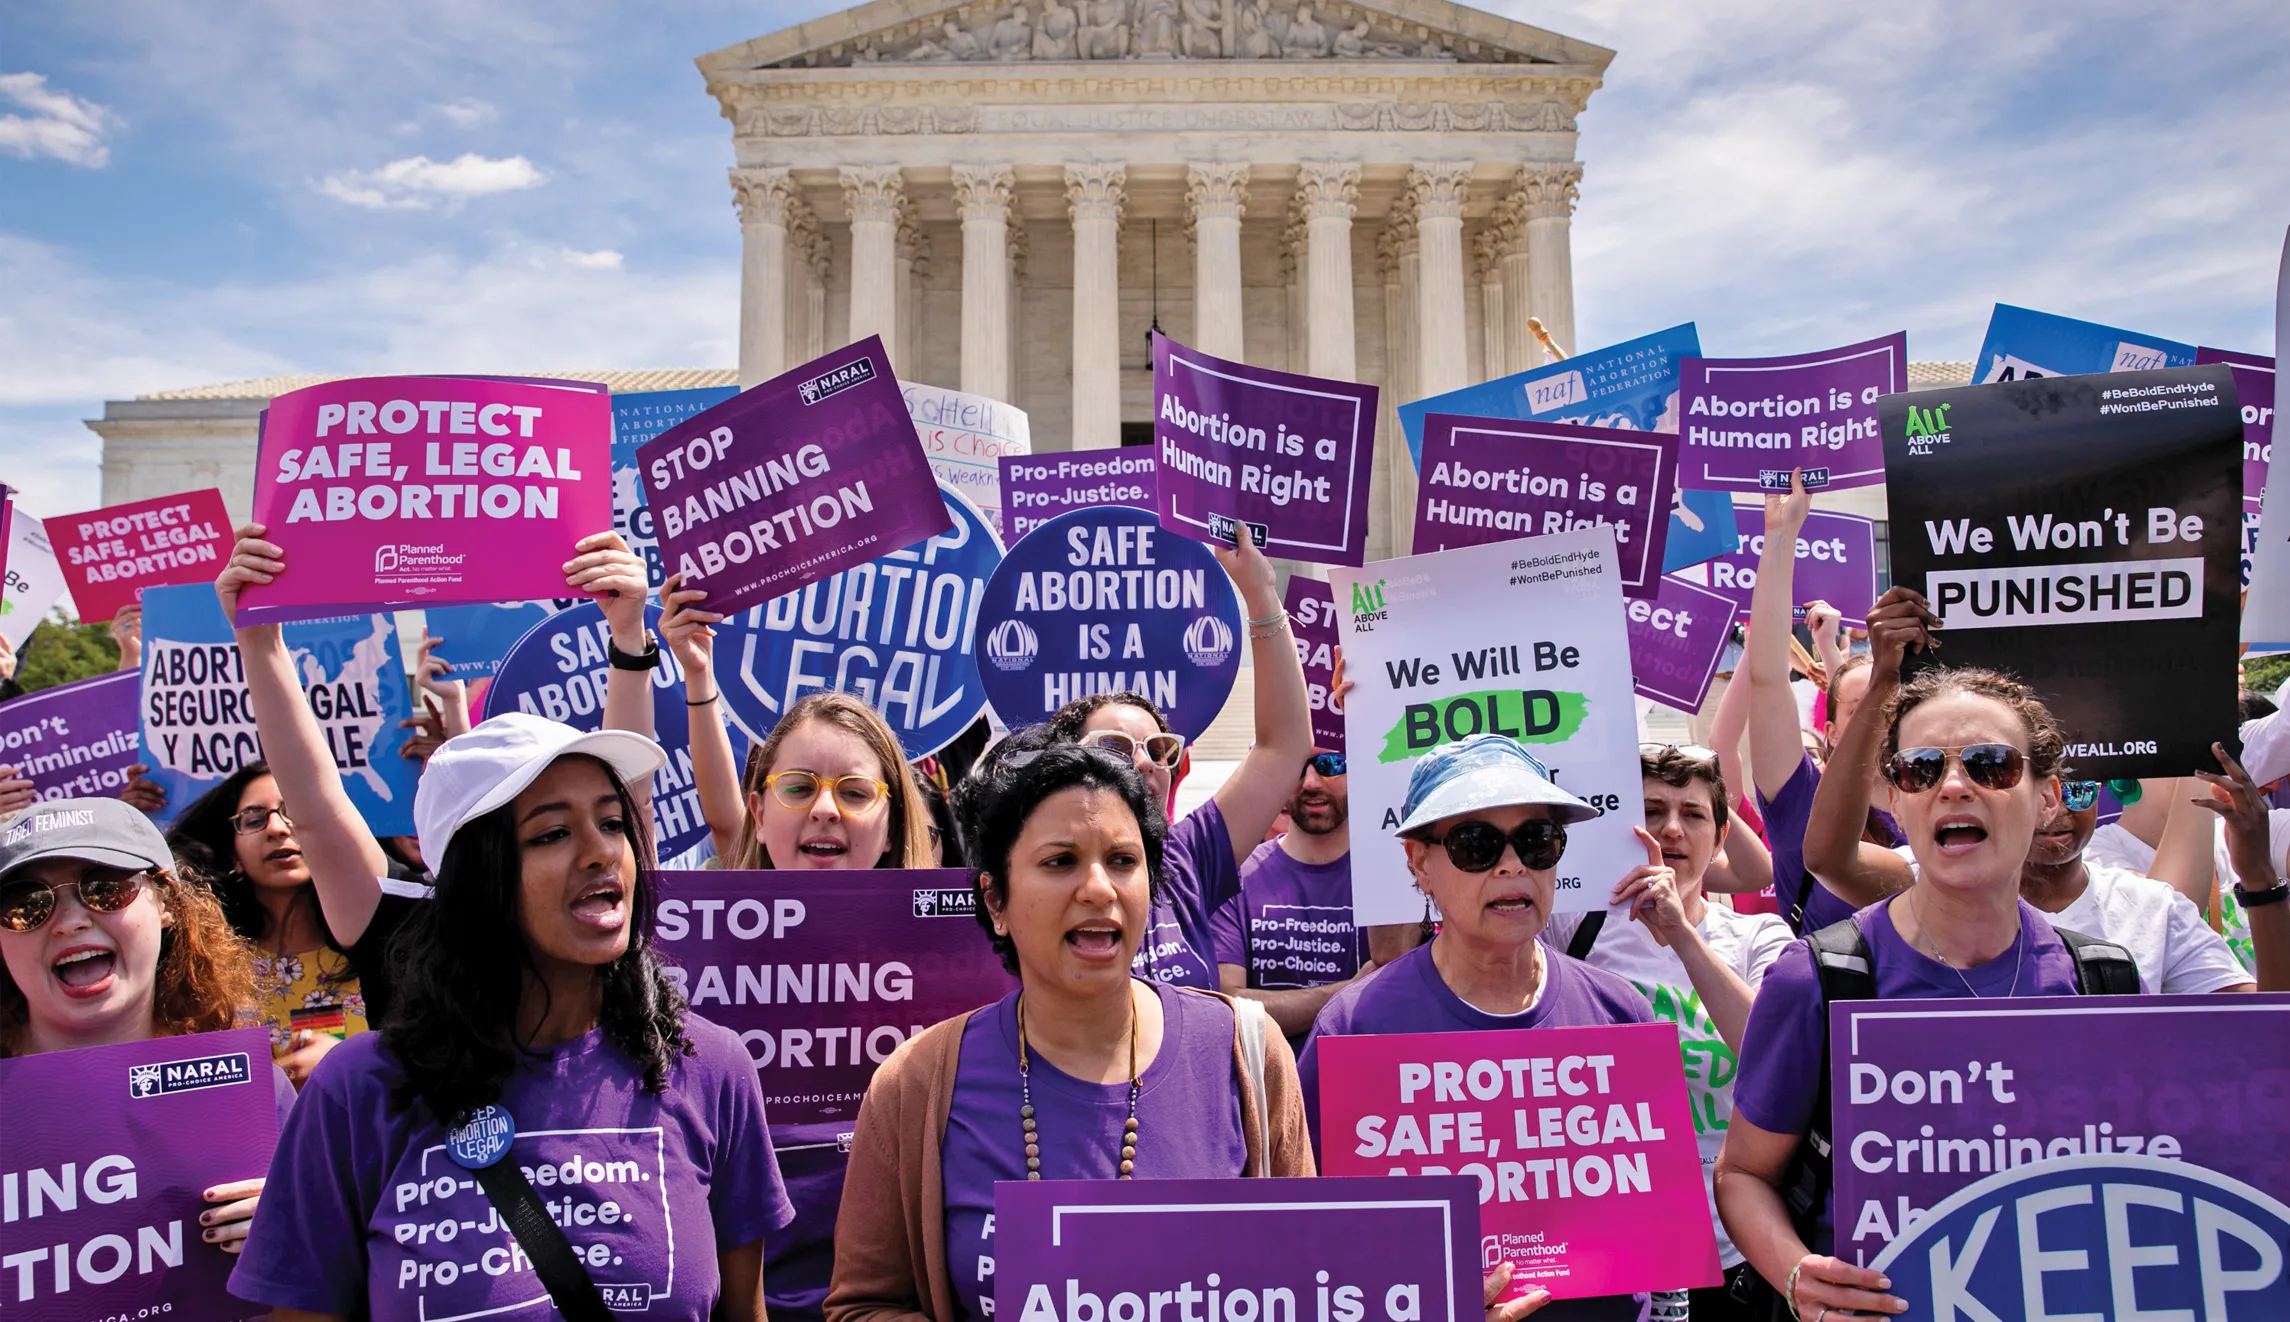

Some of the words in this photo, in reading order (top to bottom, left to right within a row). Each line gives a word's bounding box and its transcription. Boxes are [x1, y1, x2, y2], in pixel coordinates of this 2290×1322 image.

[820, 363, 869, 390] NARAL
[1586, 344, 1666, 374] NATIONAL
[1589, 356, 1668, 387] ABORTION
[1535, 369, 1576, 405] naf
[1591, 368, 1671, 398] FEDERATION
[2102, 382, 2215, 400] #BeBoldEndHyde
[316, 399, 543, 438] PROTECT
[620, 402, 707, 417] NATIONAL
[1688, 394, 1821, 418] Abortion
[1829, 387, 1852, 411] is
[1861, 385, 1879, 405] a
[2100, 396, 2219, 415] #WontBePunished
[1160, 393, 1266, 451] Abortion
[1276, 423, 1303, 456] is
[1317, 438, 1337, 462] a
[1688, 426, 1791, 449] Human
[1801, 416, 1878, 450] Right
[1907, 433, 1951, 446] ABOVE
[275, 442, 409, 484] SAFE,
[425, 442, 581, 481] LEGAL
[651, 426, 734, 491] STOP
[1908, 445, 1933, 456] ALL
[1161, 435, 1232, 488] Human
[1241, 465, 1331, 506] Right
[1429, 462, 1569, 499] Abortion
[1579, 473, 1606, 502] is
[1617, 485, 1638, 505] a
[1780, 471, 1825, 483] NRAL
[285, 484, 559, 524] ABORTION
[663, 444, 831, 540] BANNING
[1012, 483, 1149, 509] Pro-Justice.
[77, 504, 191, 541] PROTECT
[1222, 520, 1262, 539] NAL
[1426, 498, 1532, 533] Human
[1925, 518, 1994, 555] We
[2006, 507, 2130, 552] Won't
[2147, 506, 2204, 544] Be
[67, 539, 136, 566] SAFE,
[140, 522, 221, 552] LEGAL
[400, 544, 444, 554] Planned
[678, 480, 874, 588] ABORTION
[1068, 525, 1156, 567] SAFE
[1736, 534, 1848, 564] roect
[86, 543, 217, 584] ABORTION
[400, 554, 463, 565] Parenthood
[734, 534, 878, 597] WWW.PROCHOICEAMERICA.ORG
[1509, 565, 1603, 586] #WontBePunished
[1511, 550, 1600, 572] #BeBoldEndHyde
[1713, 562, 1758, 590] Ro
[1015, 569, 1205, 612] ABORTION
[1937, 570, 2191, 619] PUNISHED
[1183, 615, 1233, 653] NOW
[1354, 611, 1388, 623] ABOVE
[1355, 622, 1375, 633] ALL
[550, 618, 613, 673] SAF
[987, 619, 1039, 657] NOW
[1078, 624, 1109, 660] IS
[1122, 622, 1146, 659] A
[150, 645, 245, 687] ABORT
[1385, 657, 1441, 690] We
[1451, 645, 1521, 682] Will
[1533, 640, 1581, 672] Be
[1044, 670, 1178, 712] HUMAN
[1405, 689, 1561, 750] BOLD
[162, 733, 179, 766] Y
[5, 817, 33, 847] TIRED
[35, 810, 94, 833] FEMINIST
[942, 893, 977, 907] NAR
[655, 899, 807, 941] STOP
[1251, 917, 1355, 933] Pro-Freedom.
[1251, 937, 1346, 953] Pro-Justice.
[1252, 956, 1342, 973] Pro-Choice.
[167, 1058, 243, 1082] NARAL
[168, 1076, 212, 1088] PRO-CHOICE
[213, 1072, 244, 1083] AMERICA
[1398, 1054, 1615, 1104] PROTECT
[1849, 1060, 2016, 1105] Don't
[449, 1116, 509, 1146] ABORTION
[456, 1135, 505, 1160] LEGAL
[1354, 1111, 1501, 1159] SAFE,
[1513, 1102, 1666, 1150] LEGAL
[1849, 1121, 2183, 1174] Criminalize
[1502, 1231, 1545, 1245] Planned
[1503, 1242, 1566, 1258] Parenthood
[1928, 1182, 2283, 1322] KEEP
[602, 1288, 643, 1302] RAL
[1018, 1272, 1308, 1322] Abortion
[1316, 1270, 1364, 1322] is
[1384, 1283, 1421, 1322] a
